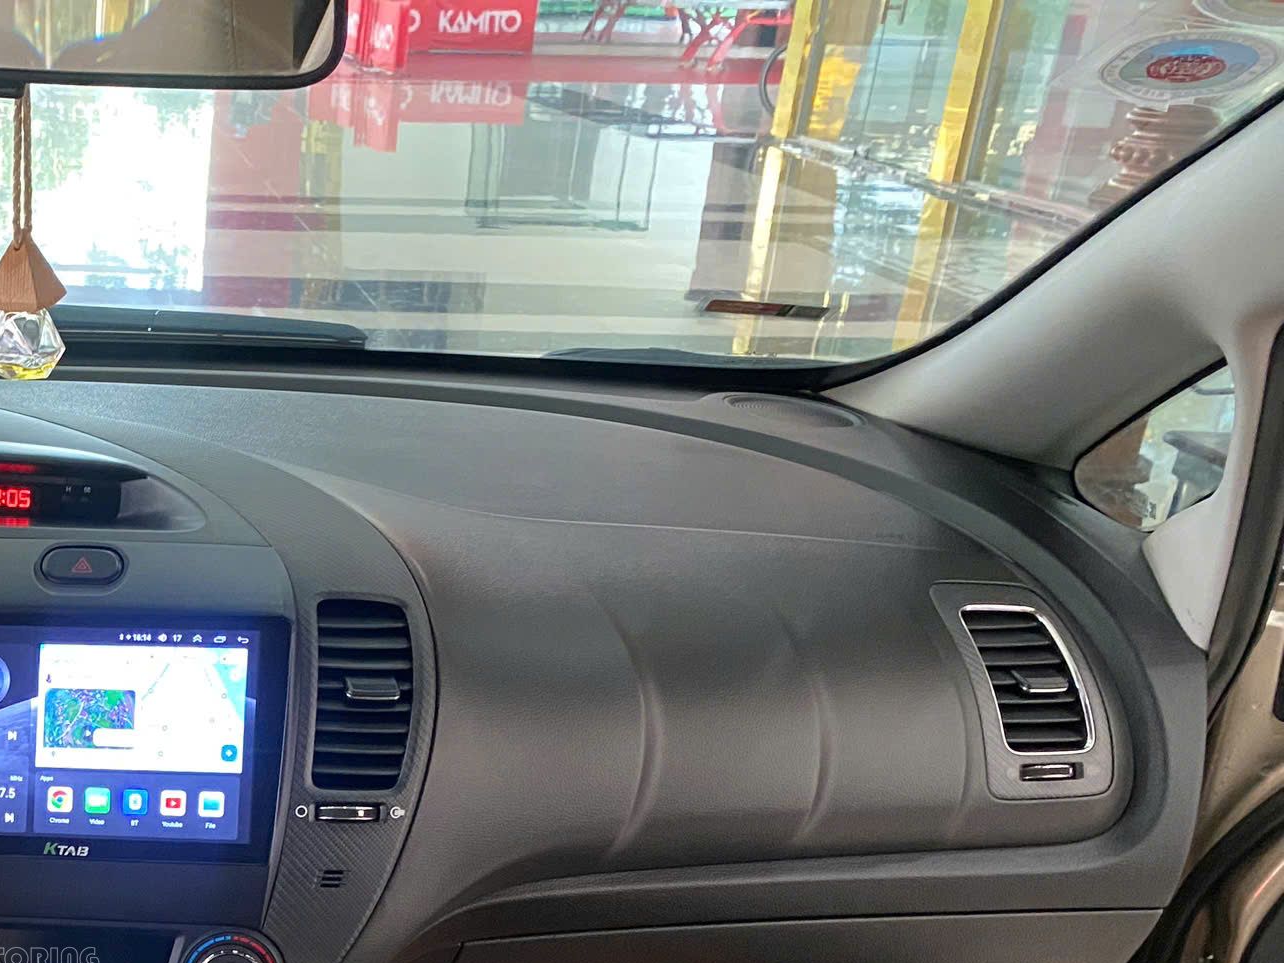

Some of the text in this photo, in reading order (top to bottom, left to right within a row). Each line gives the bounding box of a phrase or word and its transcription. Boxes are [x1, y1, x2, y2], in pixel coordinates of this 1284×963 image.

[438, 9, 522, 34] KAMITO
[49, 816, 70, 824] Chrome
[89, 817, 105, 826] Video
[43, 841, 90, 857] KTAB
